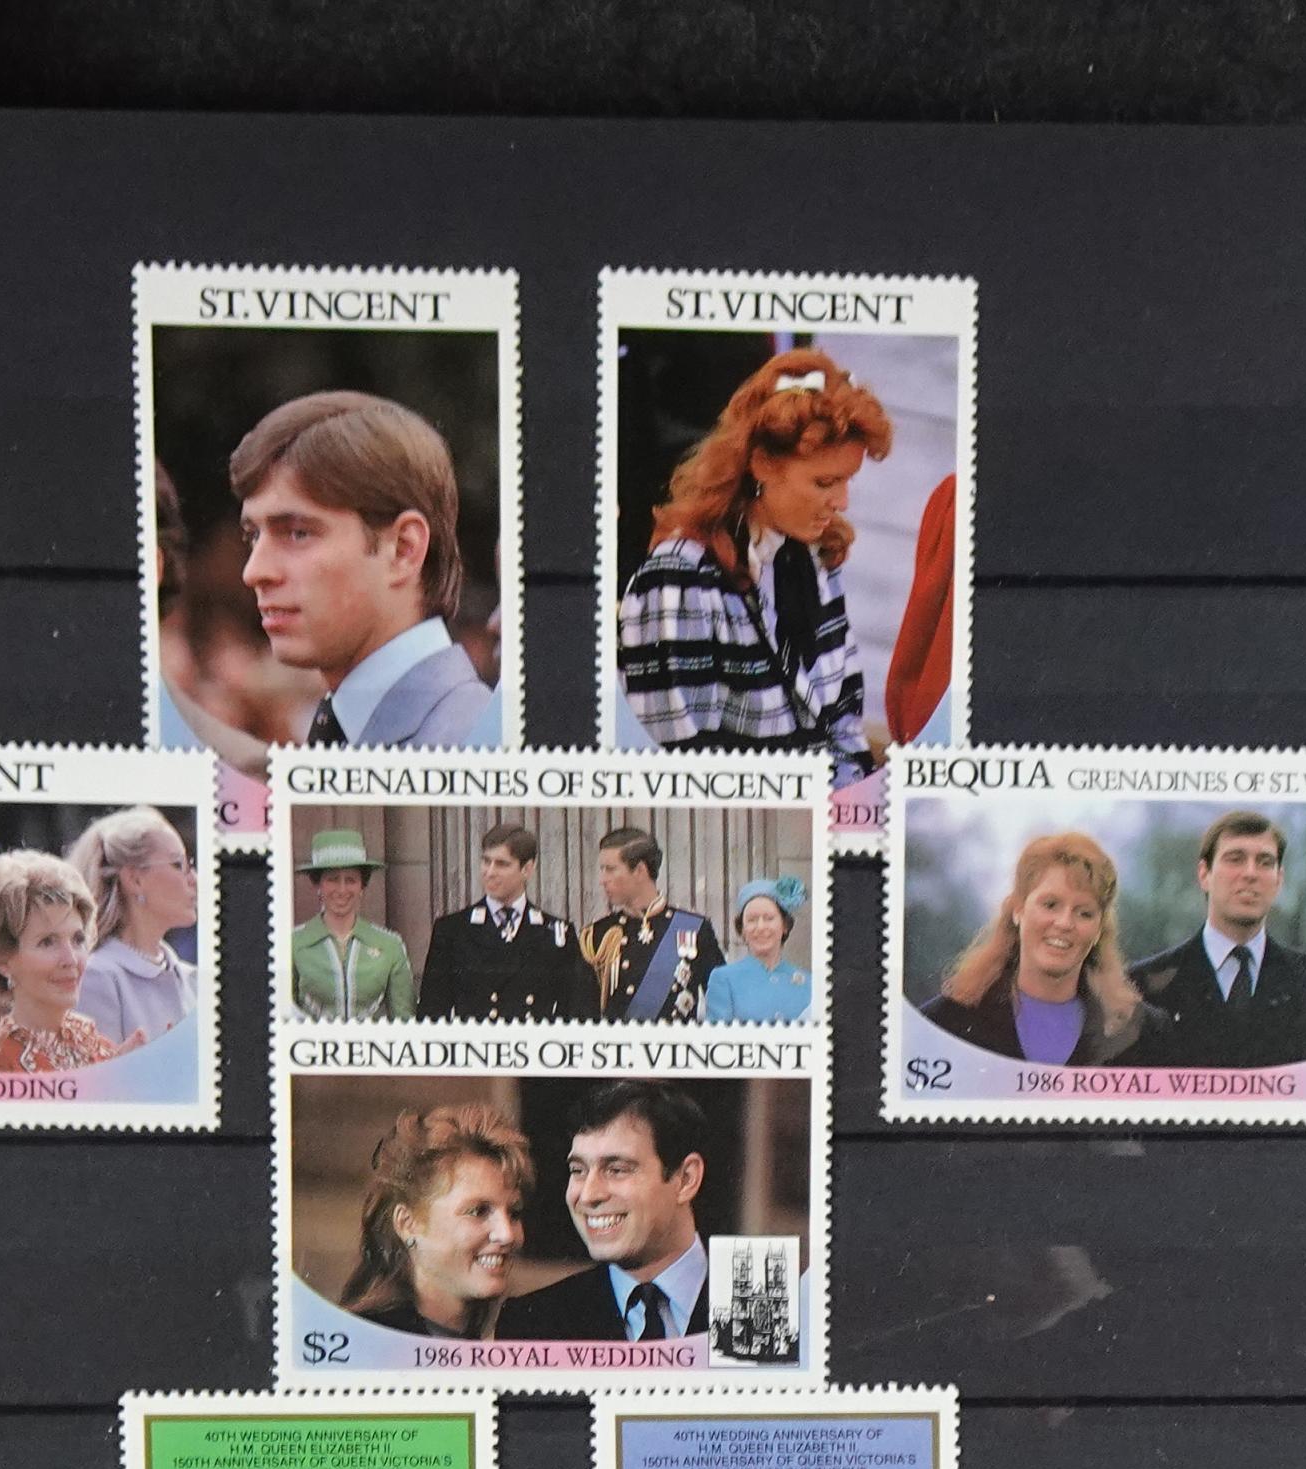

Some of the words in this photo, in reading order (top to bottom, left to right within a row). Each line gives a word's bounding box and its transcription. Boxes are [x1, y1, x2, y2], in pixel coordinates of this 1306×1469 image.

[287, 766, 529, 797] GRENADINES
[537, 768, 584, 798] OF
[904, 756, 1055, 797] BEQUIA
[1067, 767, 1228, 793] GRENADINES
[1233, 771, 1265, 793] OF
[289, 1039, 530, 1069] GRENADINES
[537, 1040, 584, 1069] OF
[905, 1056, 954, 1092] $2
[1015, 1071, 1065, 1093] 1986
[1072, 1072, 1160, 1095] ROYAL
[1169, 1073, 1297, 1096] WEDDING
[302, 1330, 351, 1364] $2
[413, 1346, 463, 1368] 1986
[470, 1346, 559, 1369] ROYAL
[565, 1346, 697, 1369] WEDDING
[204, 1430, 236, 1442] 40TH
[240, 1430, 302, 1442] WEDDING
[306, 1429, 398, 1442] ANNIVERSARY
[401, 1429, 419, 1441] OF
[673, 1430, 705, 1441] 40TH
[708, 1429, 769, 1441] WEDDING
[773, 1429, 863, 1441] ANNIVERSARY
[866, 1428, 884, 1440] OF
[261, 1443, 307, 1456] QUEEN
[310, 1443, 380, 1455] ELIZABETH
[728, 1442, 774, 1454] QUEEN
[777, 1442, 846, 1454] ELIZABETH
[173, 1456, 210, 1468] 150TH
[214, 1456, 307, 1468] ANNIVERSARY
[309, 1456, 327, 1467] OF
[331, 1456, 376, 1468] QUEEN
[381, 1455, 453, 1467] VICTORIA'S
[643, 1456, 680, 1468] 150TH
[683, 1455, 773, 1467] ANNIVERSARY
[776, 1455, 795, 1466] OF
[797, 1454, 842, 1466] QUEEN
[846, 1453, 917, 1466] VICTORIA'S
